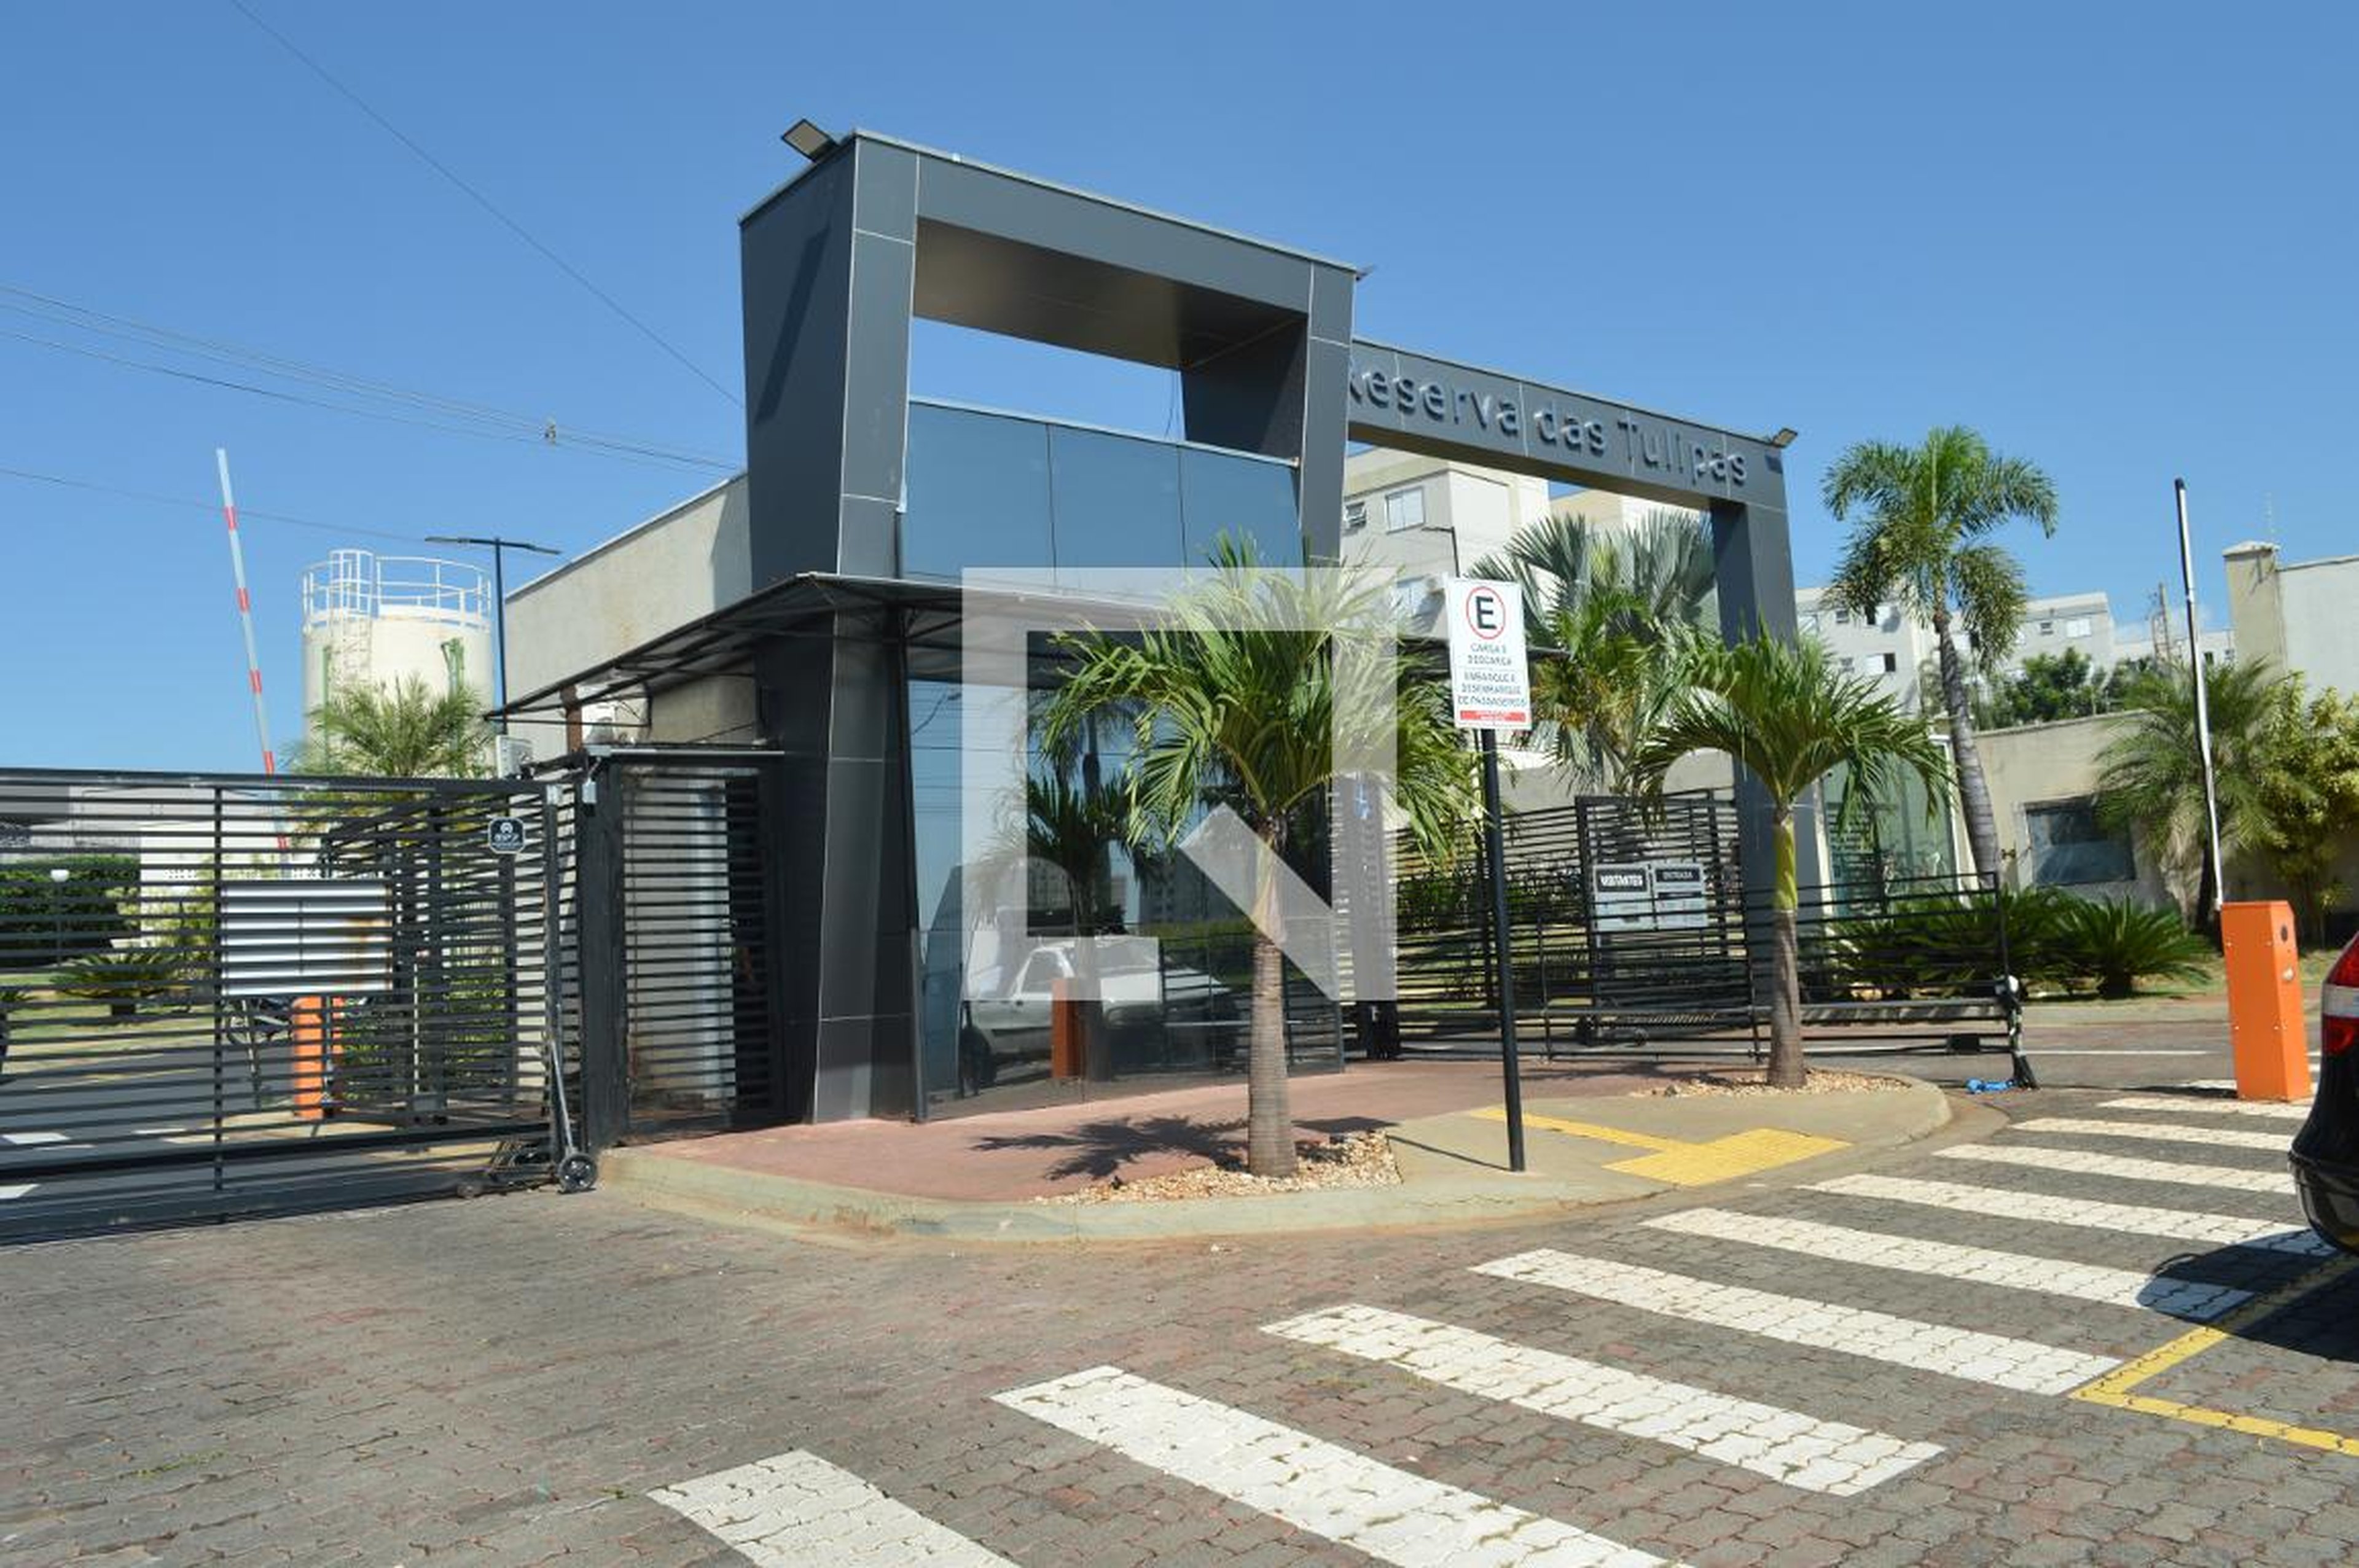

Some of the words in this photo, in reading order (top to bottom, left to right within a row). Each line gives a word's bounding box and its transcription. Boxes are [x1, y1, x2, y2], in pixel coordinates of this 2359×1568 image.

[1533, 400, 1605, 458] das
[1617, 417, 1748, 486] Tulipas
[1476, 595, 1498, 630] E
